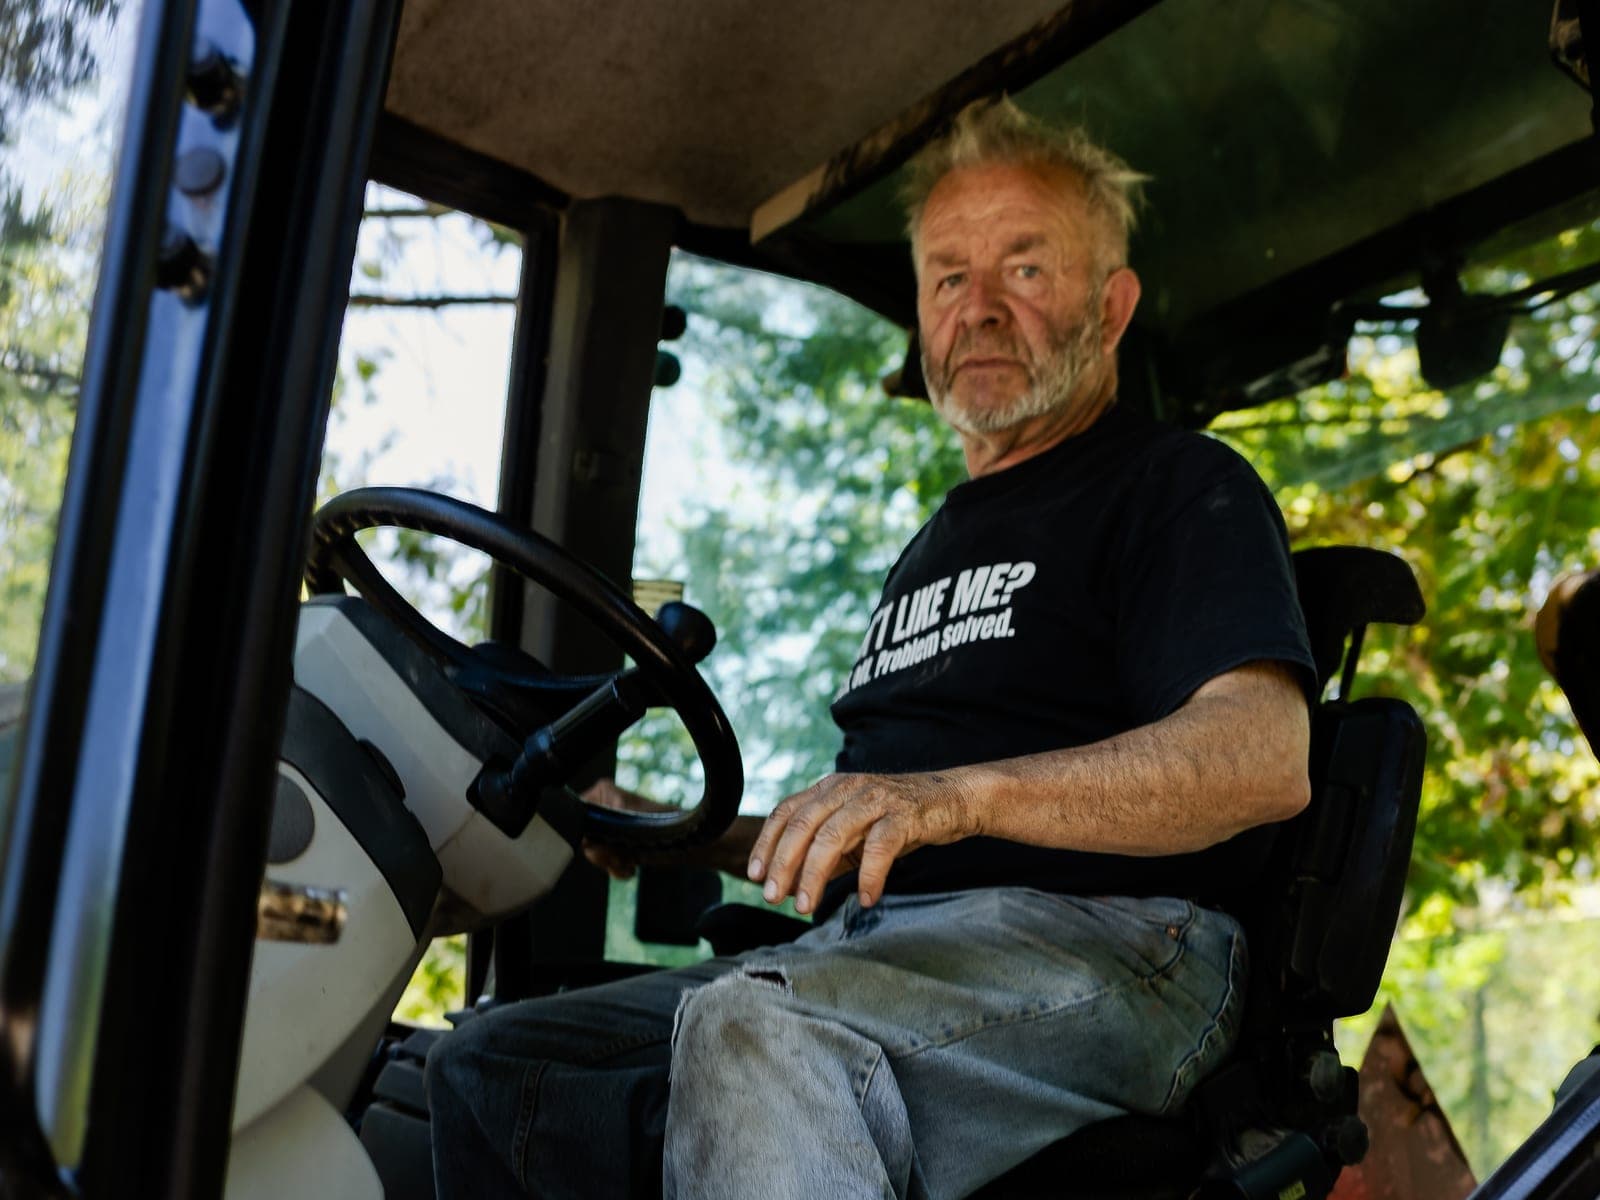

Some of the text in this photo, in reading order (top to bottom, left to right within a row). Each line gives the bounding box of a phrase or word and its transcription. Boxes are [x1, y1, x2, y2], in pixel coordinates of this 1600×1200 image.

[892, 577, 952, 643] LIKE
[949, 561, 1036, 618] ME?
[874, 630, 940, 679] Problem
[941, 607, 1016, 651] solved.
